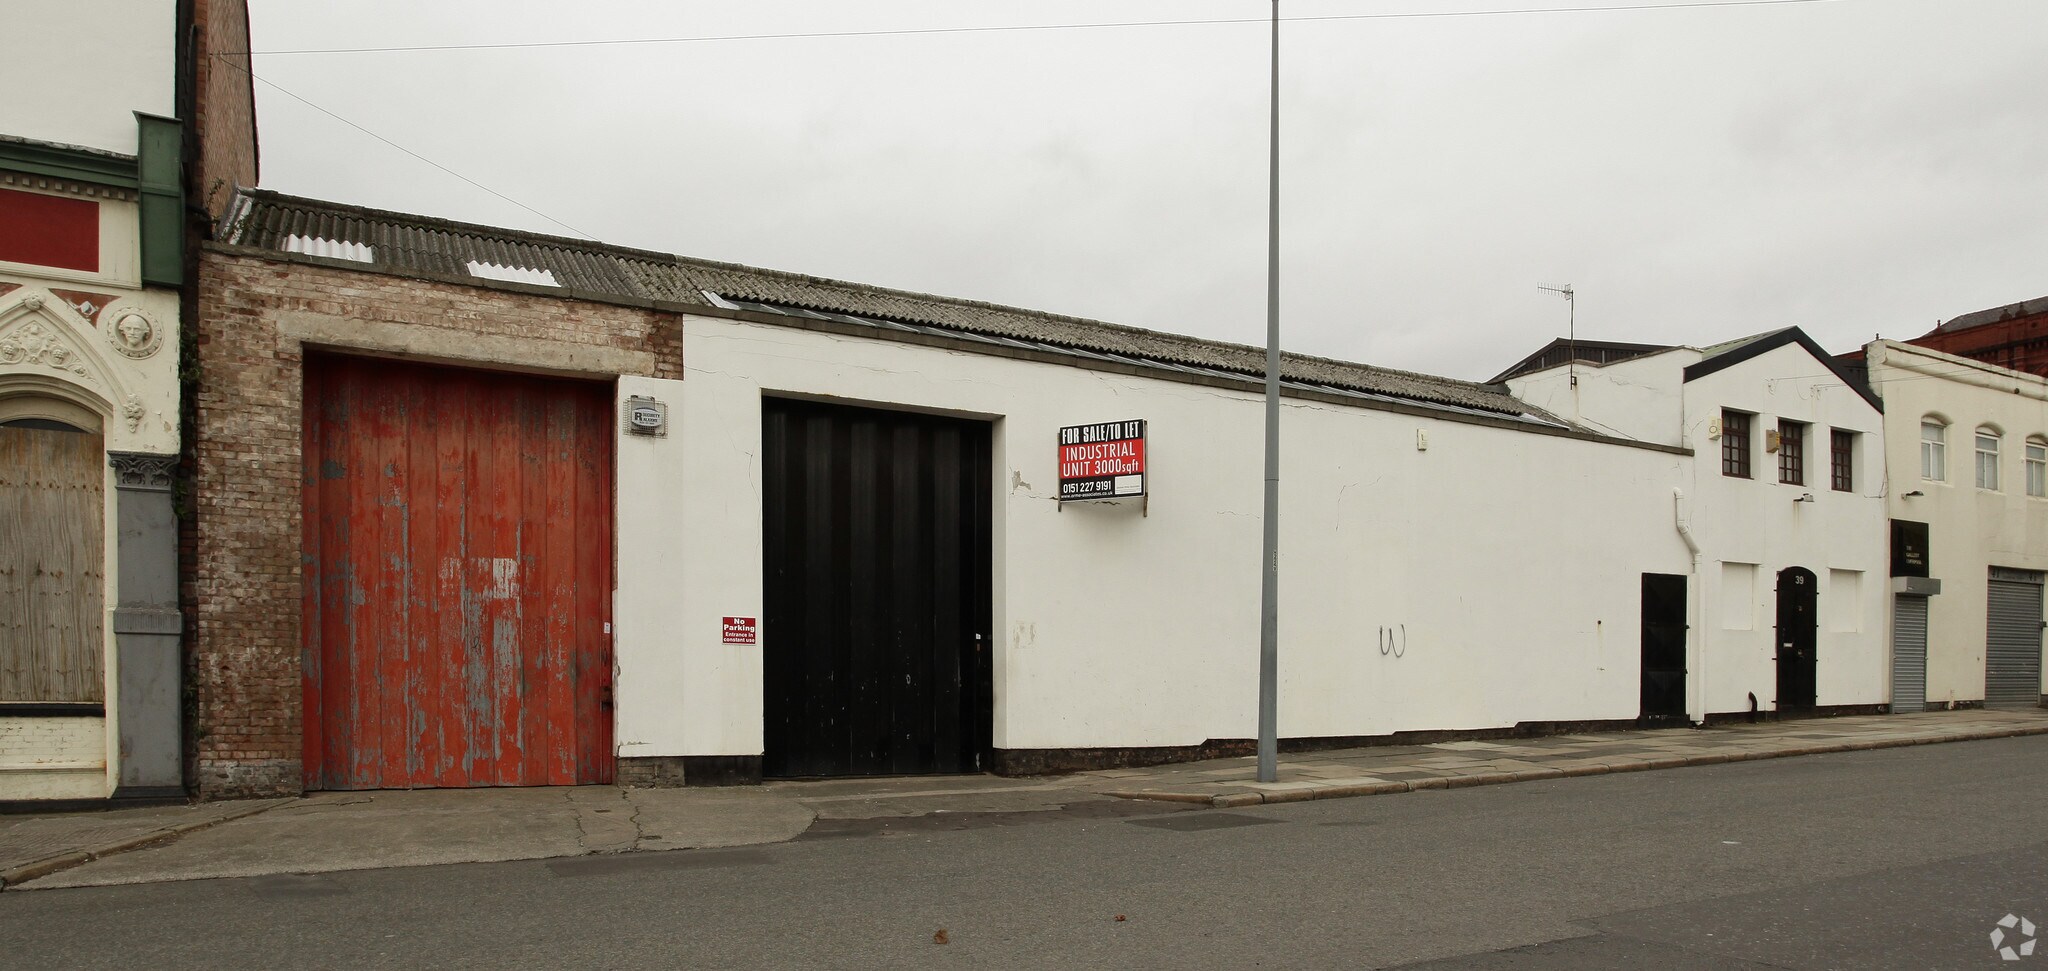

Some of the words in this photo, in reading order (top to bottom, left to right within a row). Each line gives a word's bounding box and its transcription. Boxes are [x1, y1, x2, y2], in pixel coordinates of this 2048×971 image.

[634, 412, 642, 421] R
[1062, 428, 1080, 445] FOR
[1083, 423, 1121, 442] SALE/TO
[1125, 421, 1139, 439] LET
[1066, 442, 1136, 462] INDUSTRIAL
[1063, 461, 1091, 477] UNIT
[1094, 458, 1139, 475] 3000sqft
[1063, 482, 1079, 494] 0151
[1080, 481, 1095, 492] 227
[1095, 480, 1112, 491] 9191
[1795, 575, 1804, 585] 39
[723, 624, 755, 633] Parking
